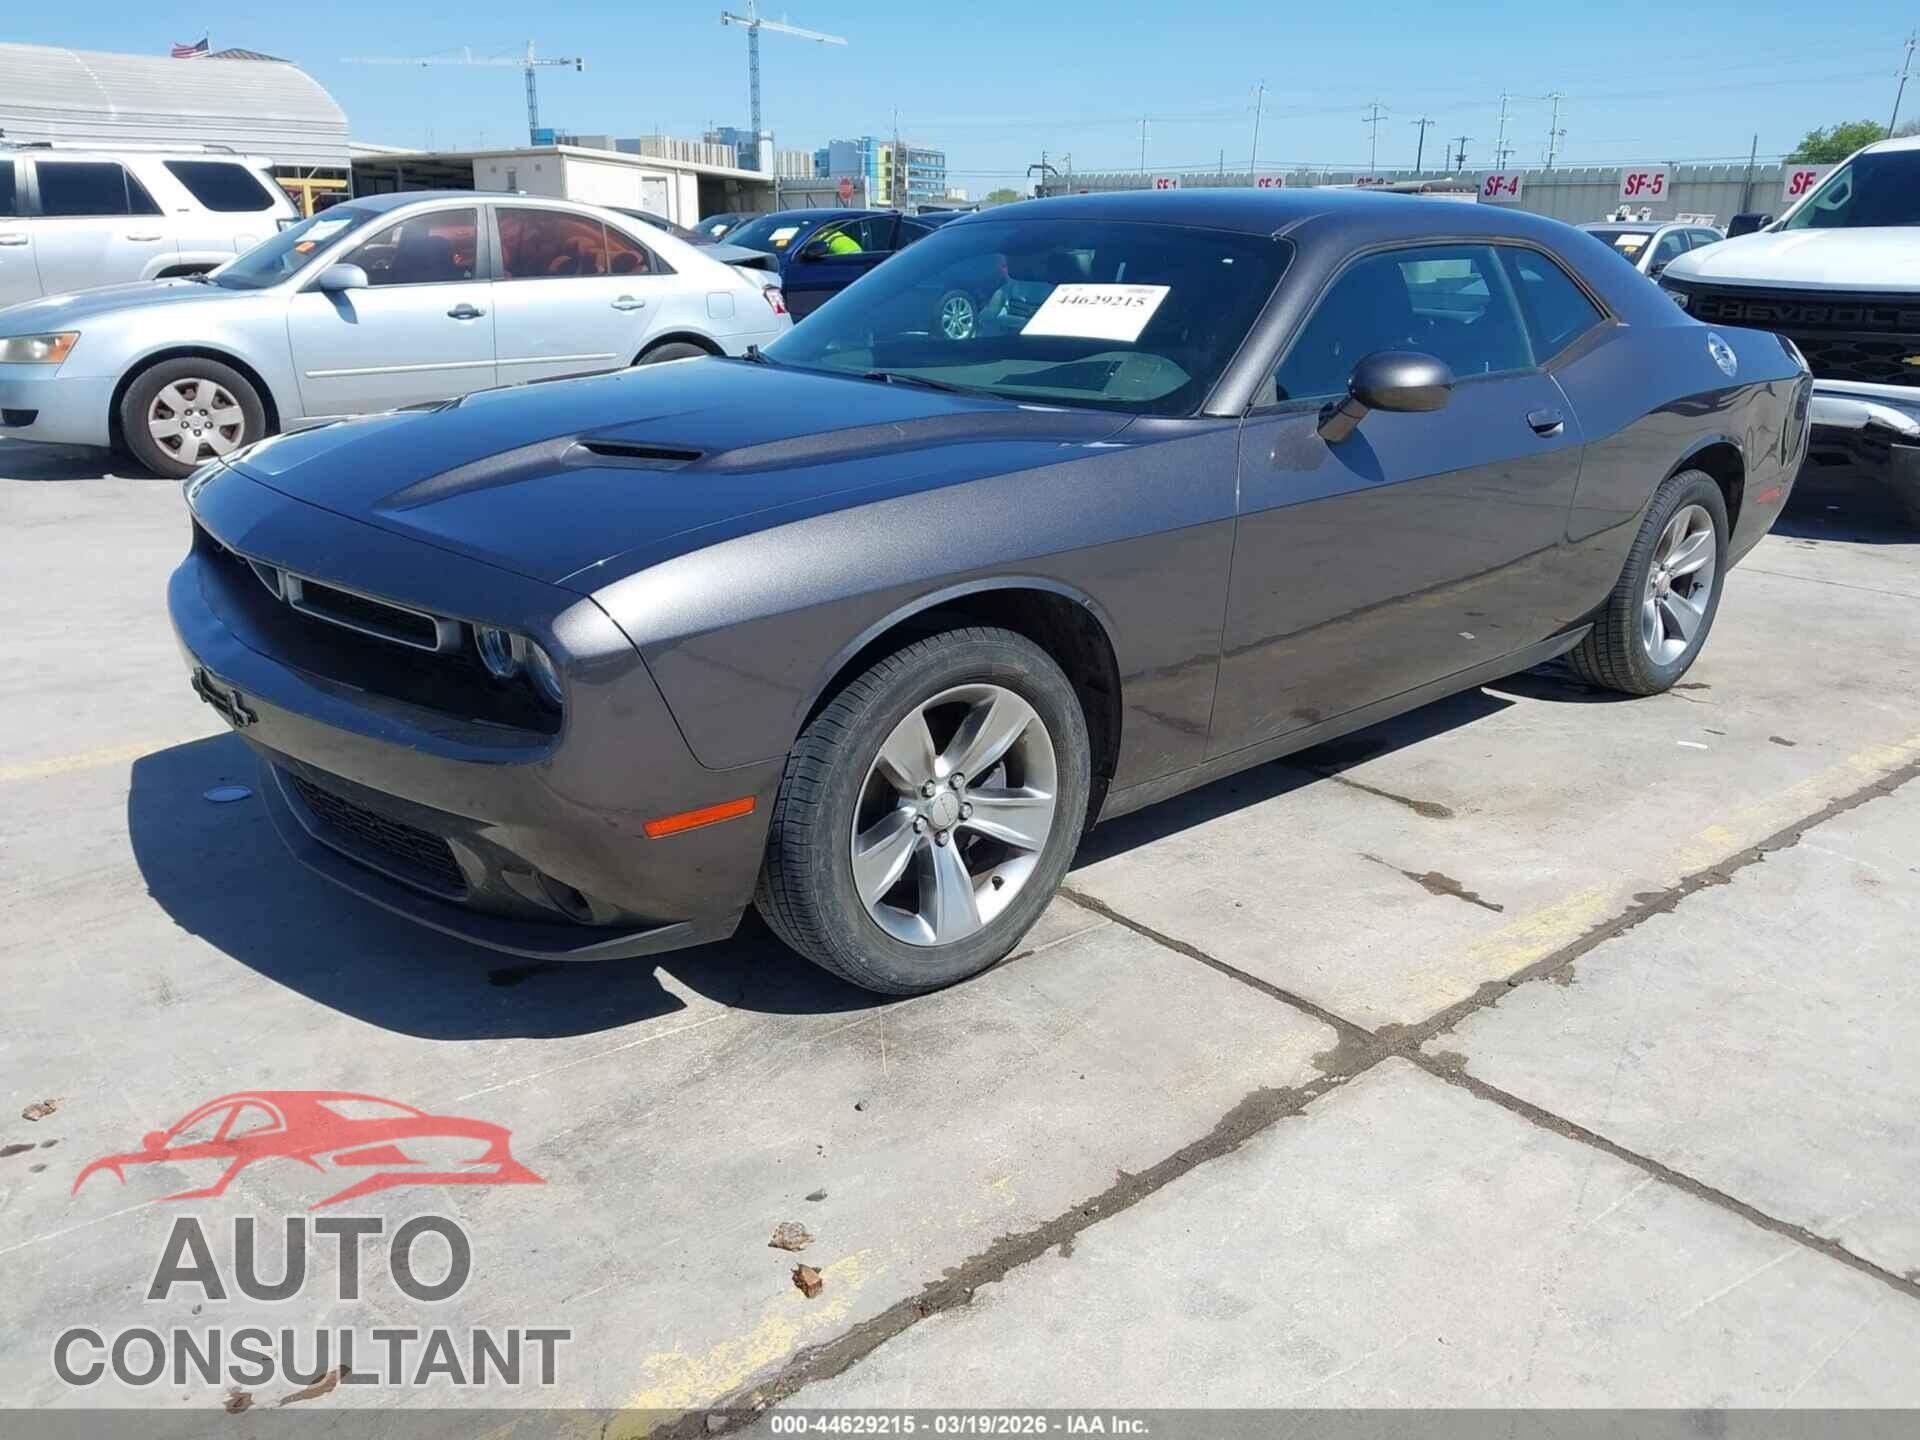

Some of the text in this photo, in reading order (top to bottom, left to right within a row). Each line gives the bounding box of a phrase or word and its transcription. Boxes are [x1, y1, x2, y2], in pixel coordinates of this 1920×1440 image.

[1485, 175, 1519, 196] SF-4
[1625, 173, 1664, 195] SF-5
[1789, 172, 1817, 195] SF
[1057, 295, 1147, 307] 44629215
